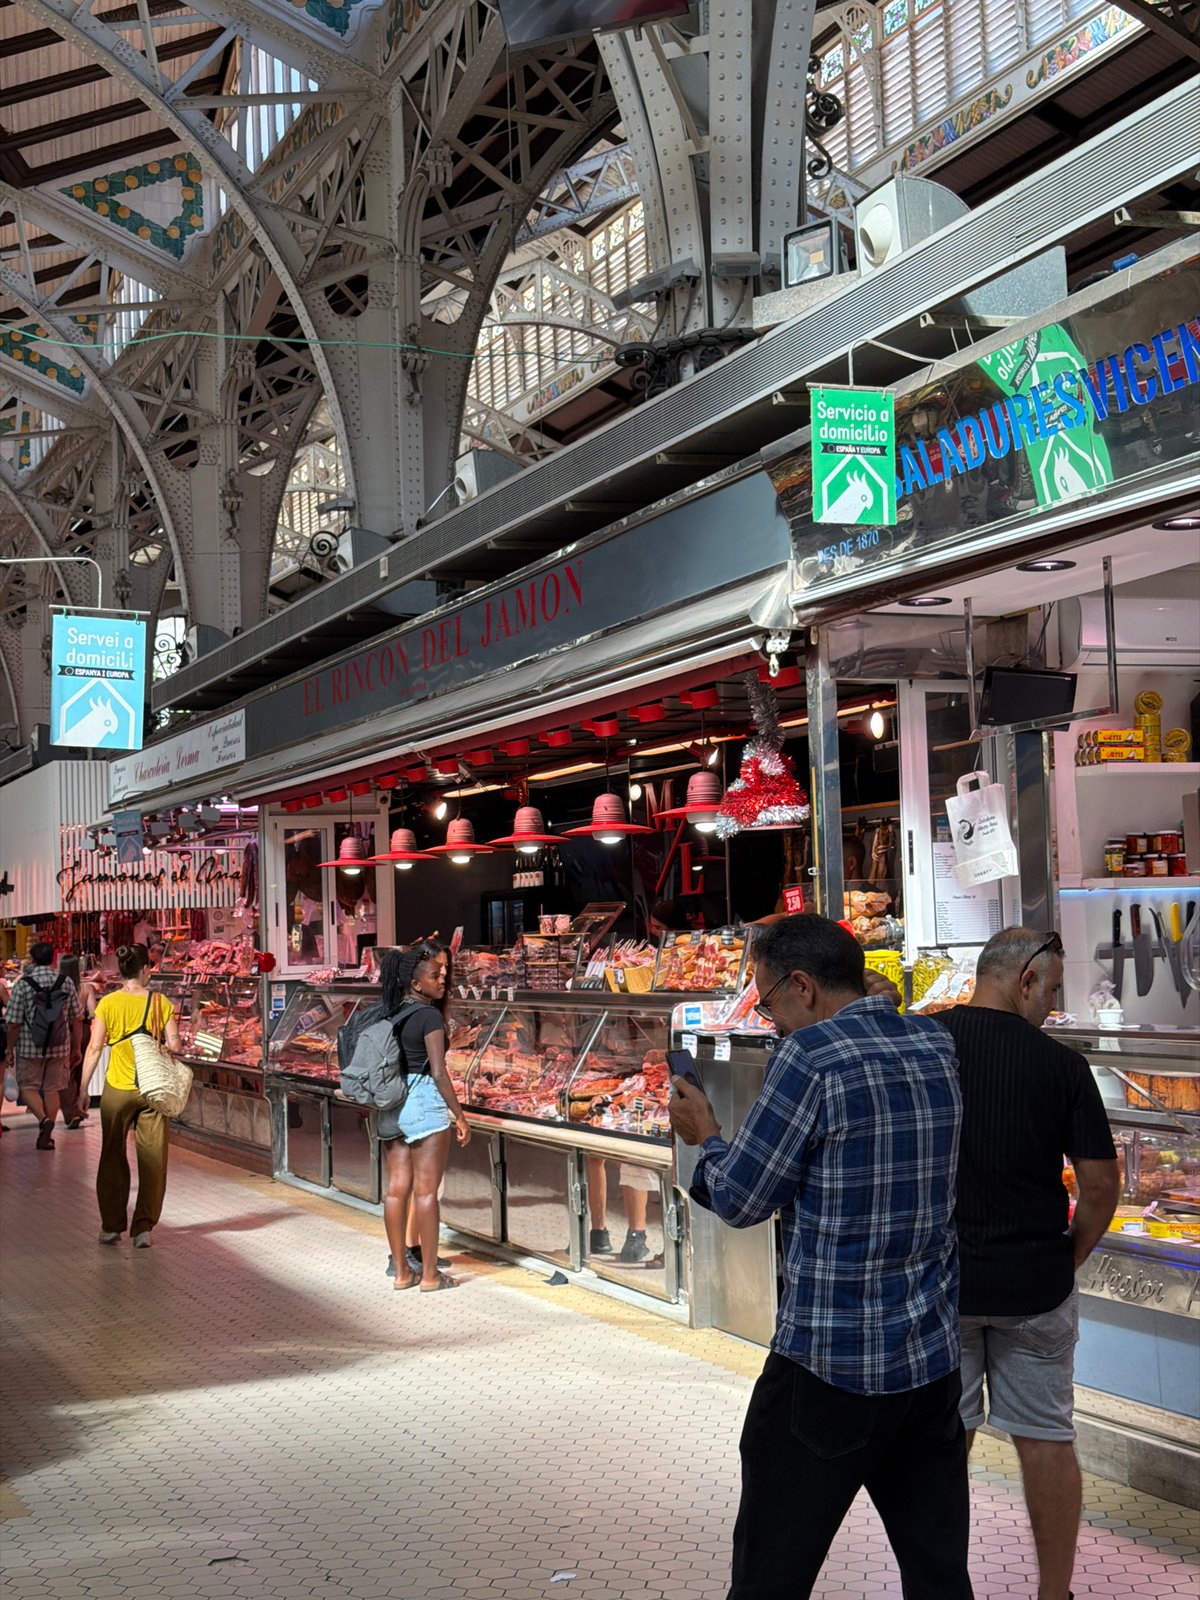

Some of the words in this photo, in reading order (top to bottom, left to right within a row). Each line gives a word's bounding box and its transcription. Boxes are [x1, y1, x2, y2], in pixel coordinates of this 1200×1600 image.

[817, 400, 877, 422] Servicio
[880, 410, 889, 423] a
[819, 420, 888, 443] domicilio
[896, 370, 1087, 501] ALADURES
[836, 444, 856, 453] ESPAÑA
[860, 446, 881, 455] EUROPA
[855, 529, 880, 551] 1870
[67, 627, 119, 648] Servei
[123, 636, 134, 649] a
[303, 676, 325, 718] EL
[331, 638, 410, 707] RINCON
[421, 614, 469, 671] DEL
[480, 559, 584, 648] JAMON
[66, 647, 133, 668] domicili
[74, 668, 102, 677] ESPANYA
[106, 671, 130, 679] EUROPA
[56, 860, 166, 903] Jamones
[171, 865, 188, 882] el
